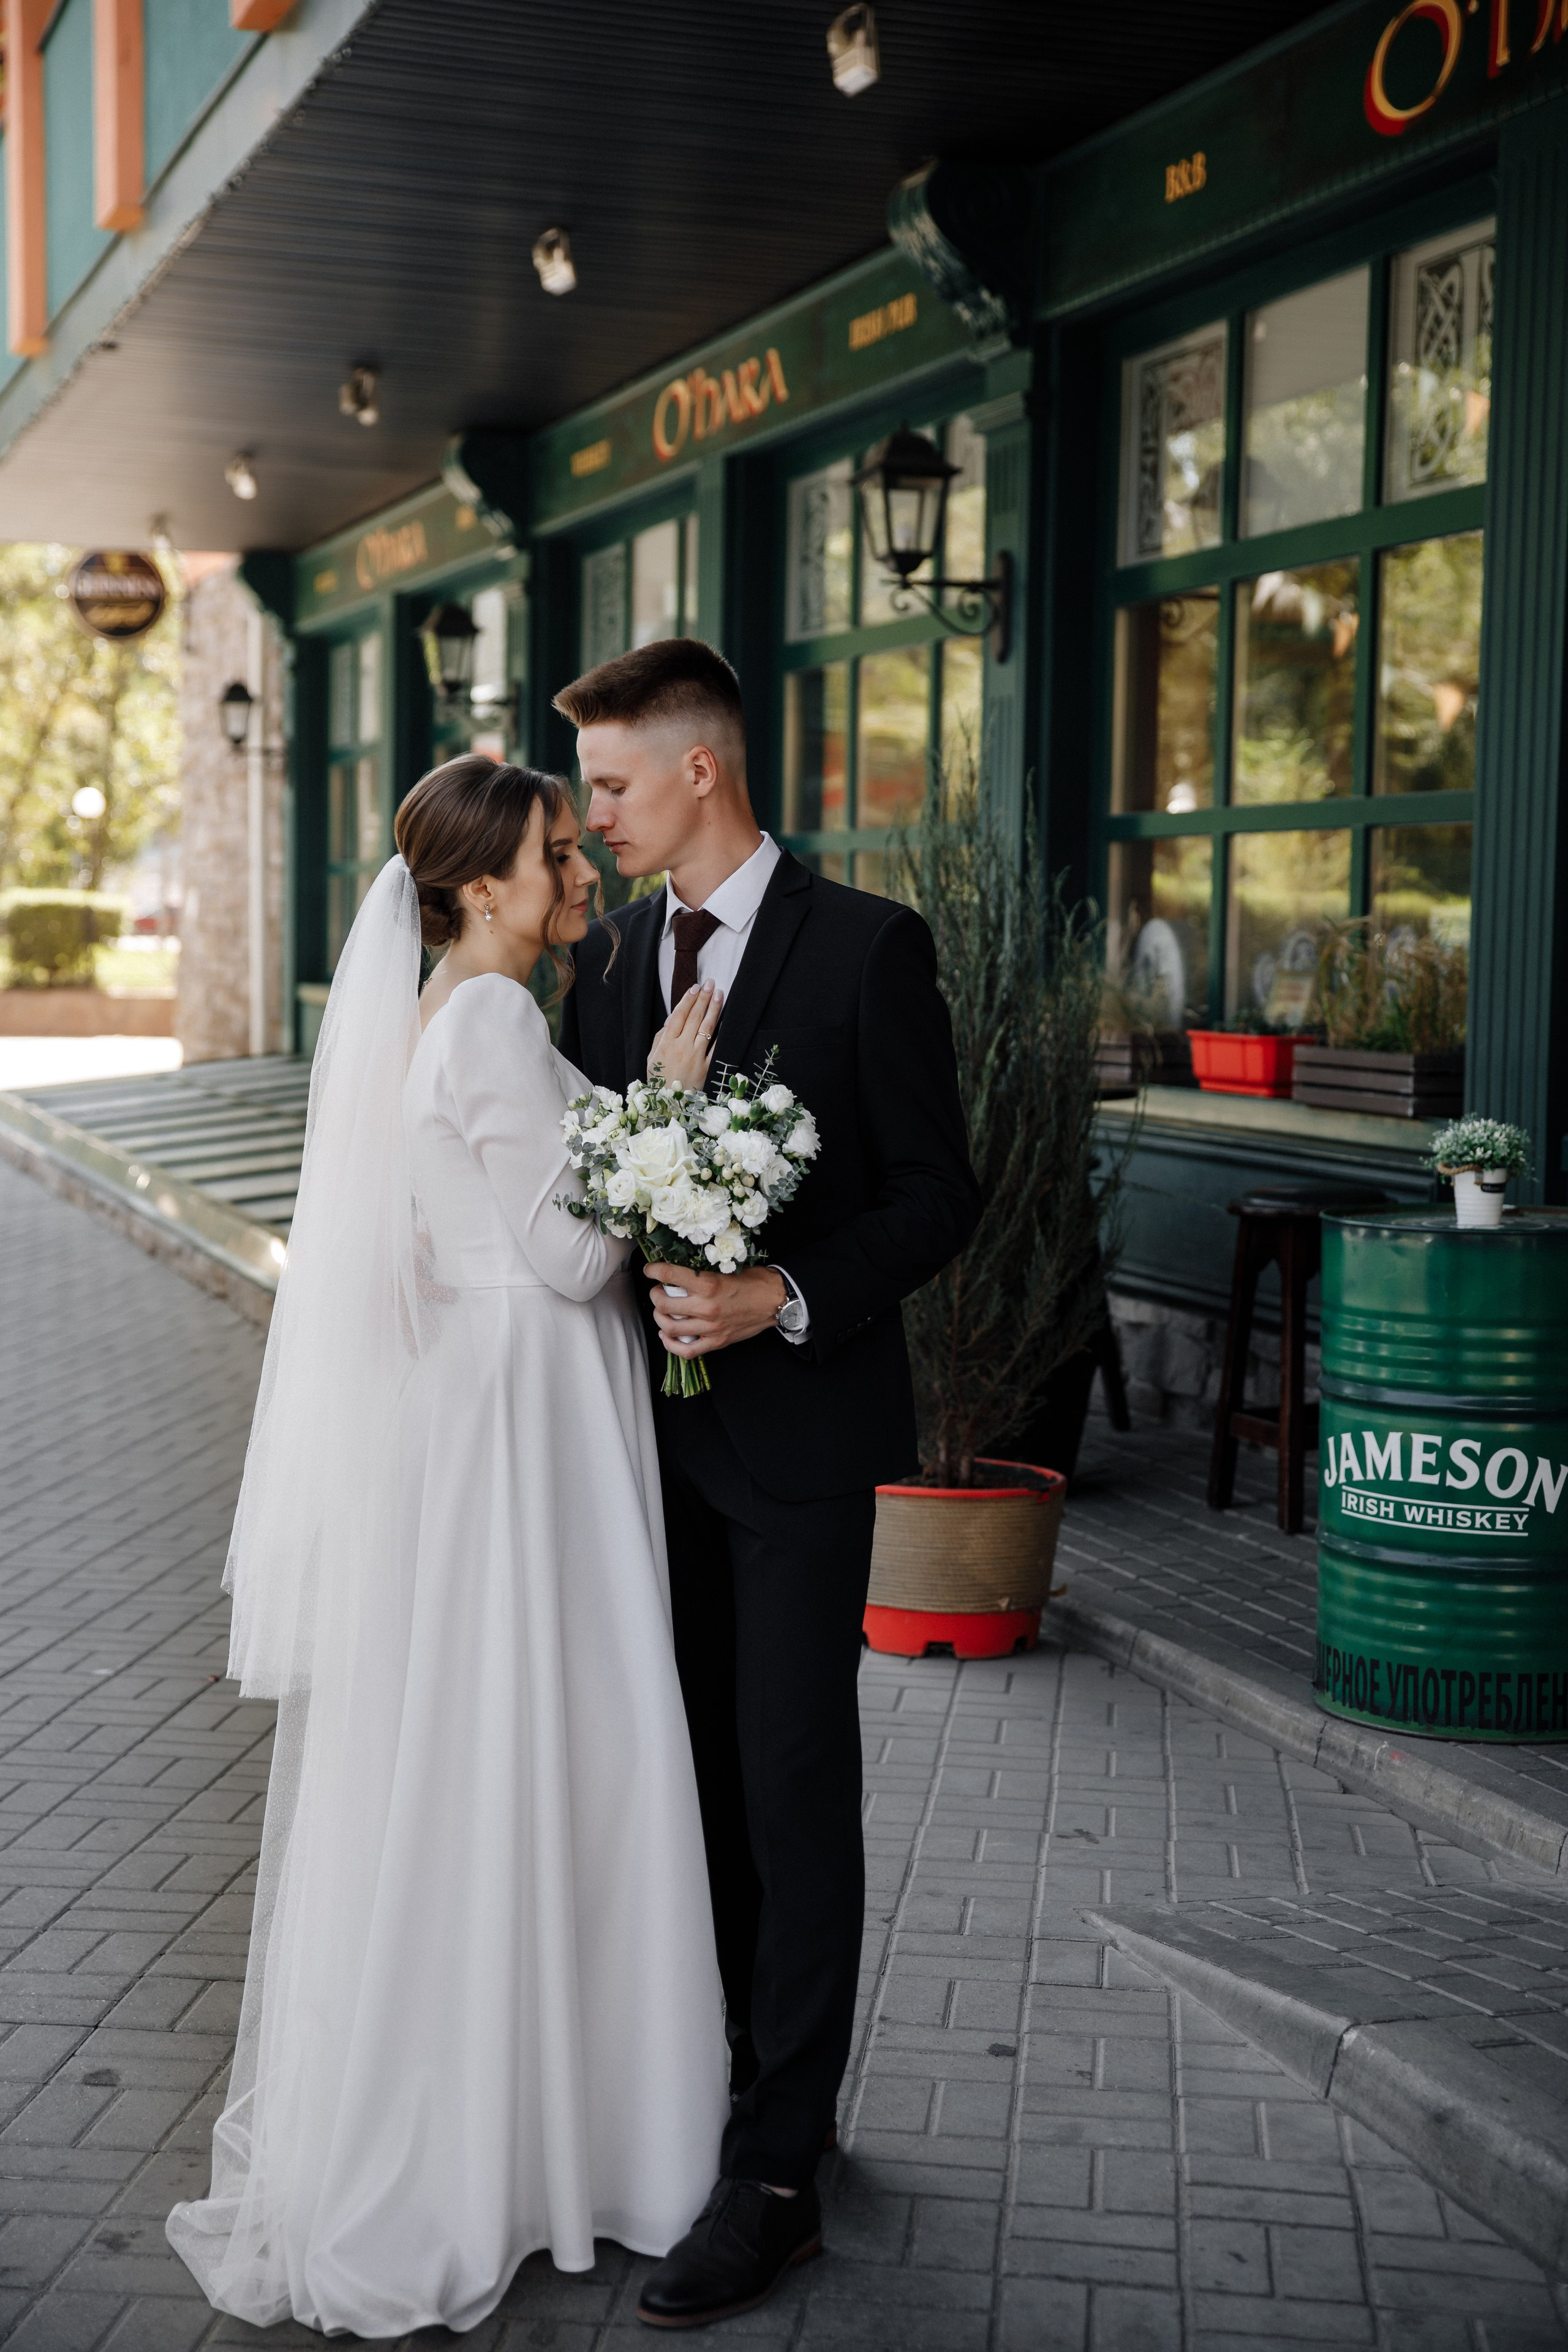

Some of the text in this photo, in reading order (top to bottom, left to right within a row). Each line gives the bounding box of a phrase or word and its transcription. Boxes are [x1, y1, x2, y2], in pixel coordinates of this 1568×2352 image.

[1324, 1431, 1568, 1514] JAMESON
[1341, 1491, 1529, 1531] IRISH WHISKEY
